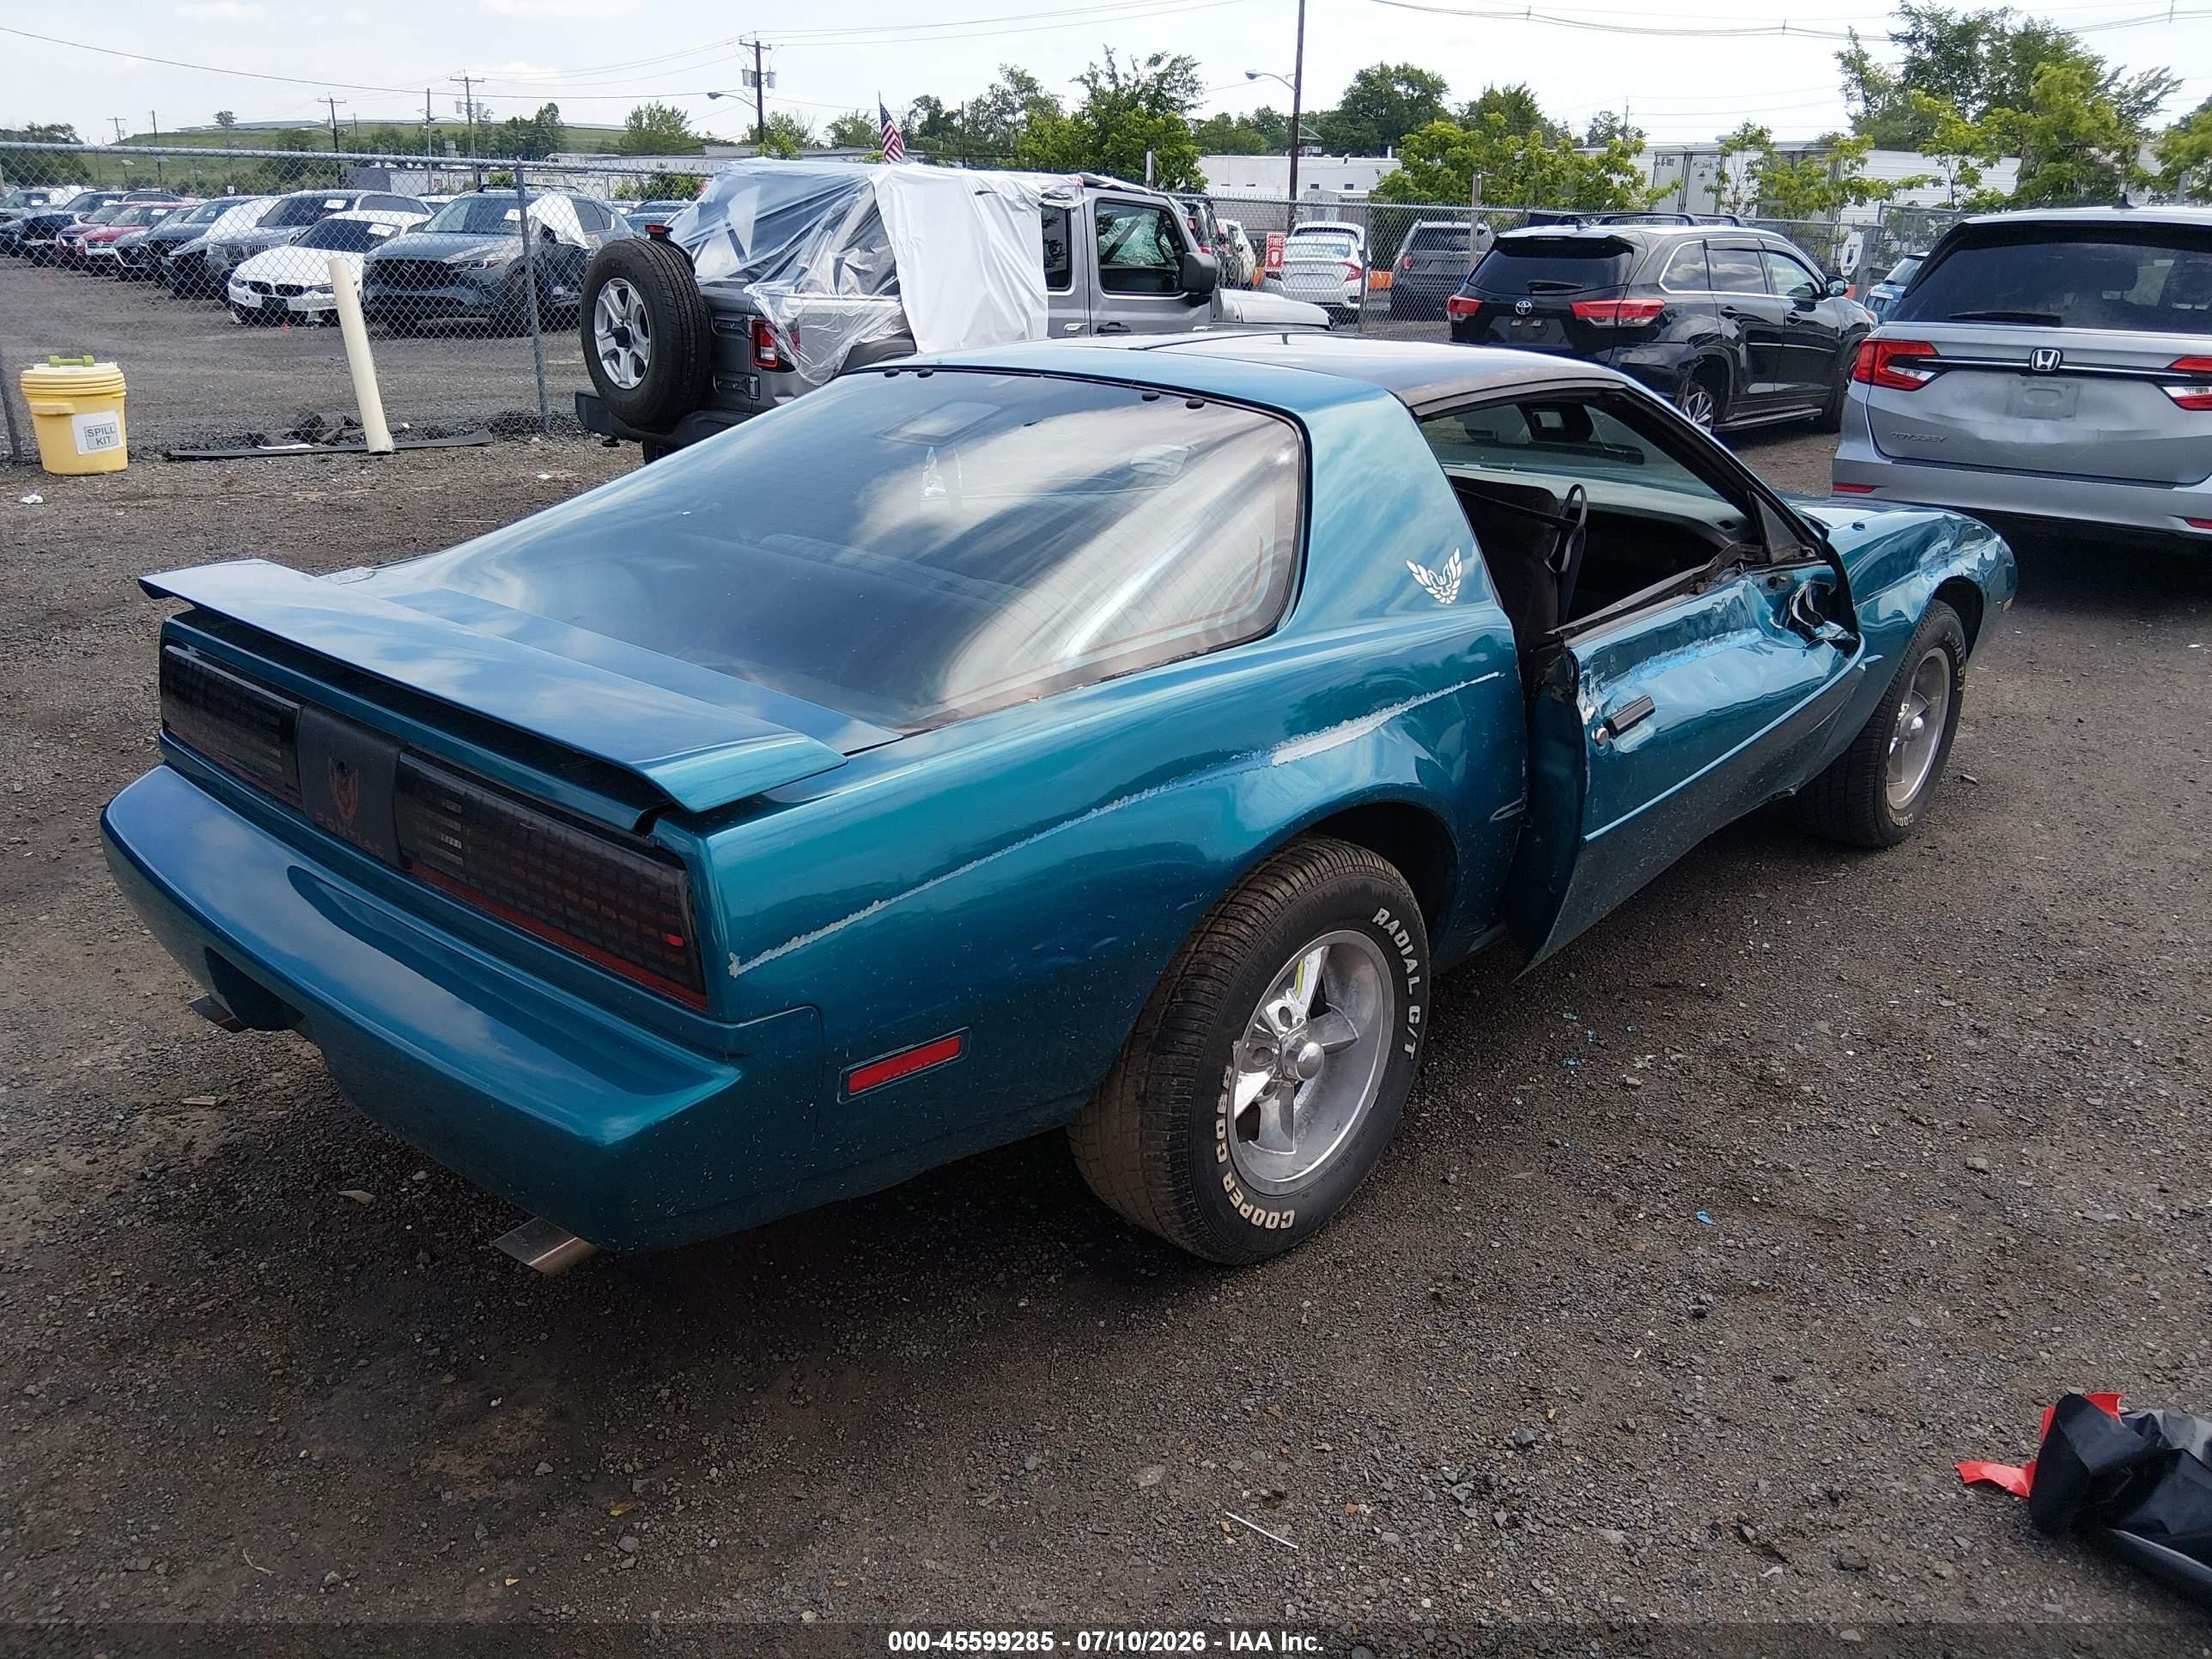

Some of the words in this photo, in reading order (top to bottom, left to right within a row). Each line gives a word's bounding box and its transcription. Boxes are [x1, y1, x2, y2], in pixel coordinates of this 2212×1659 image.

[1269, 237, 1283, 246] FIRE
[87, 426, 117, 437] SPILL
[1889, 431, 1948, 443] ODYSSEY
[96, 435, 112, 446] KIT
[1372, 907, 1420, 995] RADIAL
[1223, 1170, 1296, 1229] COOPER
